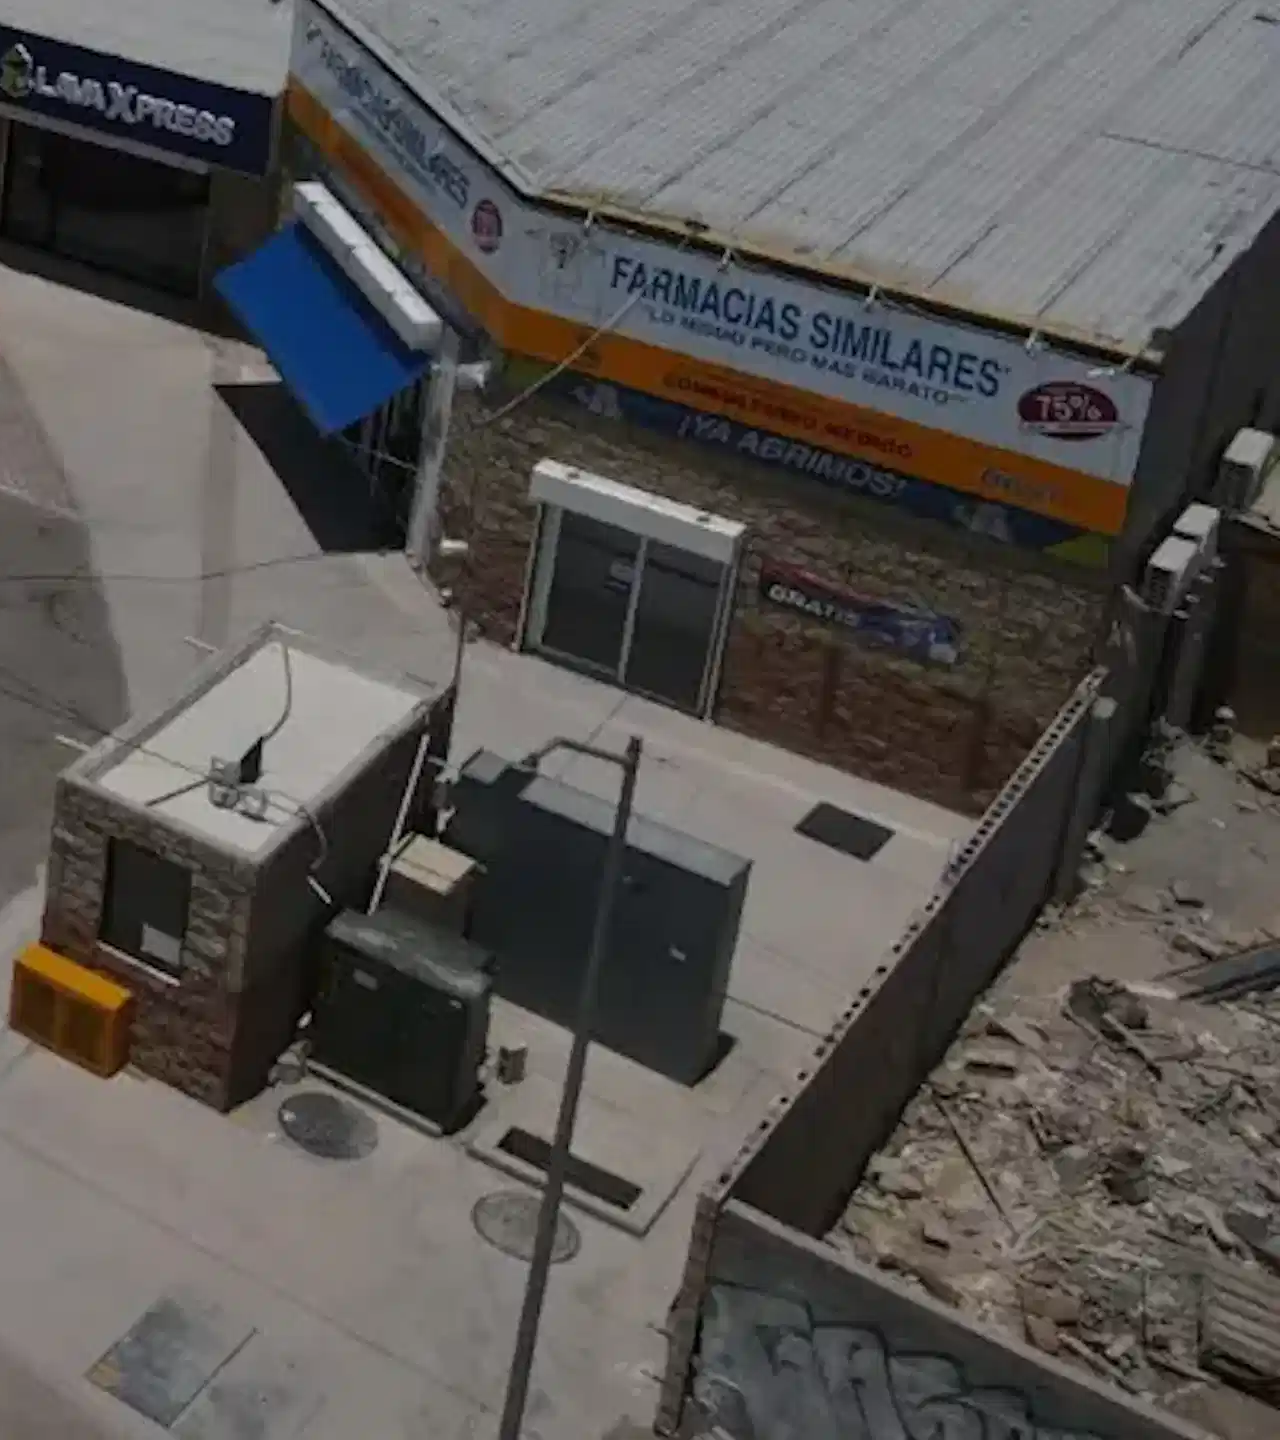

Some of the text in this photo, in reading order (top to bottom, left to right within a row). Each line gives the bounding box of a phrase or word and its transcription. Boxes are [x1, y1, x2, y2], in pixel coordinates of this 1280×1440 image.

[610, 255, 1000, 398] FARMACIAS SIMILARES
[751, 336, 807, 364] PERO
[1035, 393, 1103, 422] 75%
